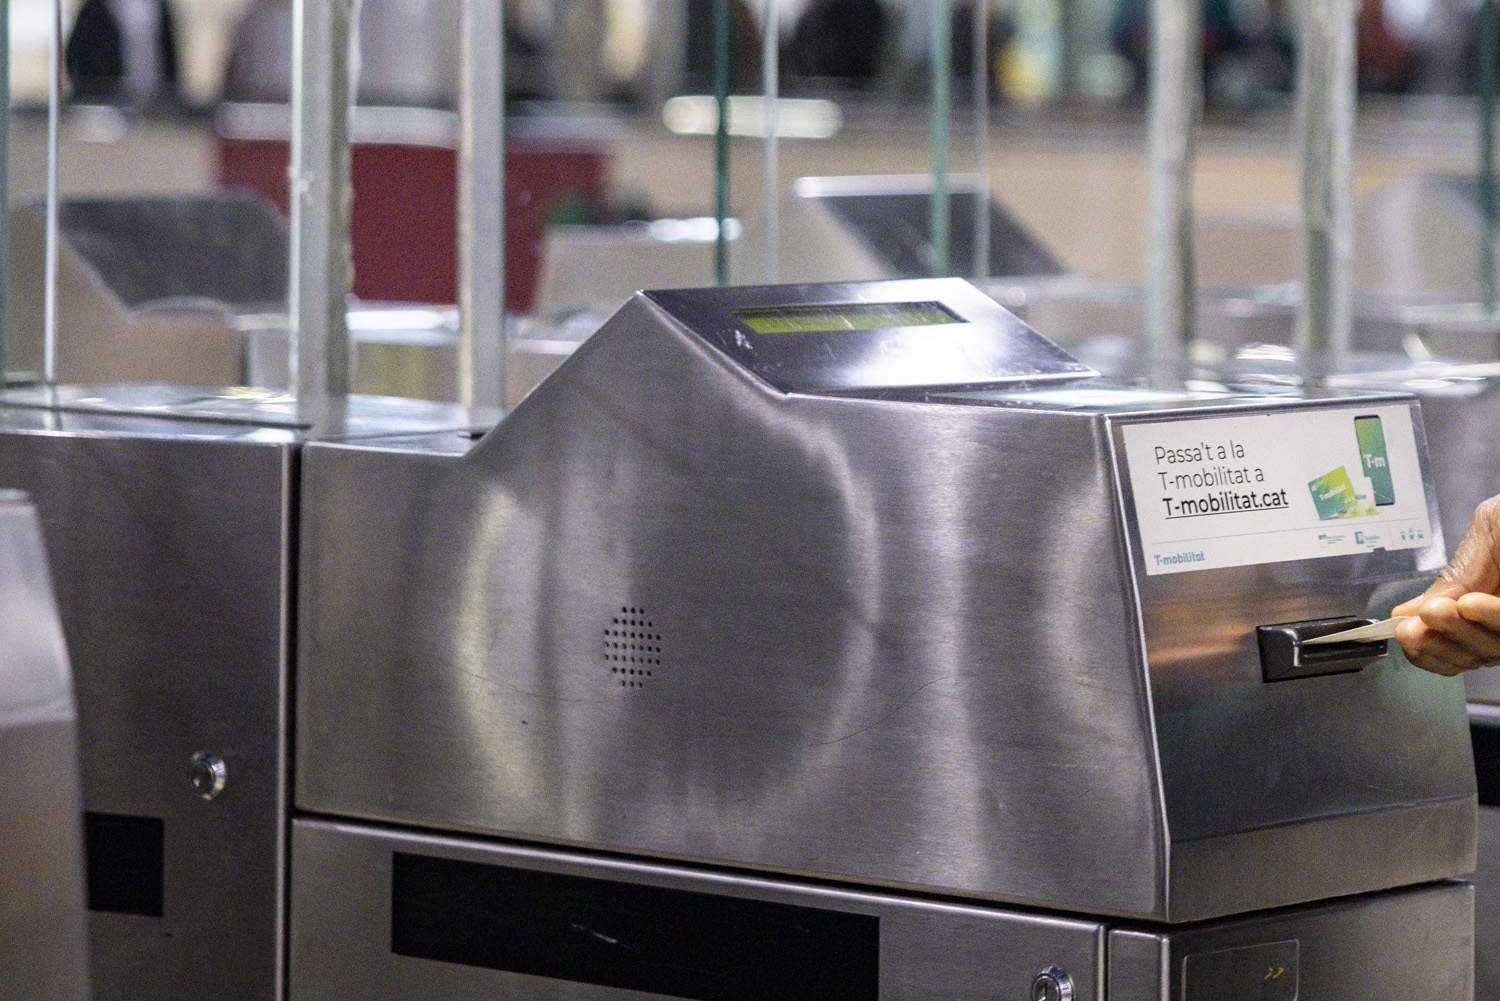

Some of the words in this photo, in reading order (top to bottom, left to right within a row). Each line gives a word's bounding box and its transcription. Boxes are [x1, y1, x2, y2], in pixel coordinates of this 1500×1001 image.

[1154, 442, 1213, 465] Passa't
[1217, 445, 1225, 460] a
[1231, 440, 1245, 460] la
[1157, 467, 1251, 491] T-mobilitat
[1255, 469, 1264, 483] a
[1162, 488, 1288, 517] T-mobilitat.cat
[1153, 551, 1205, 567] T-mobilitat
